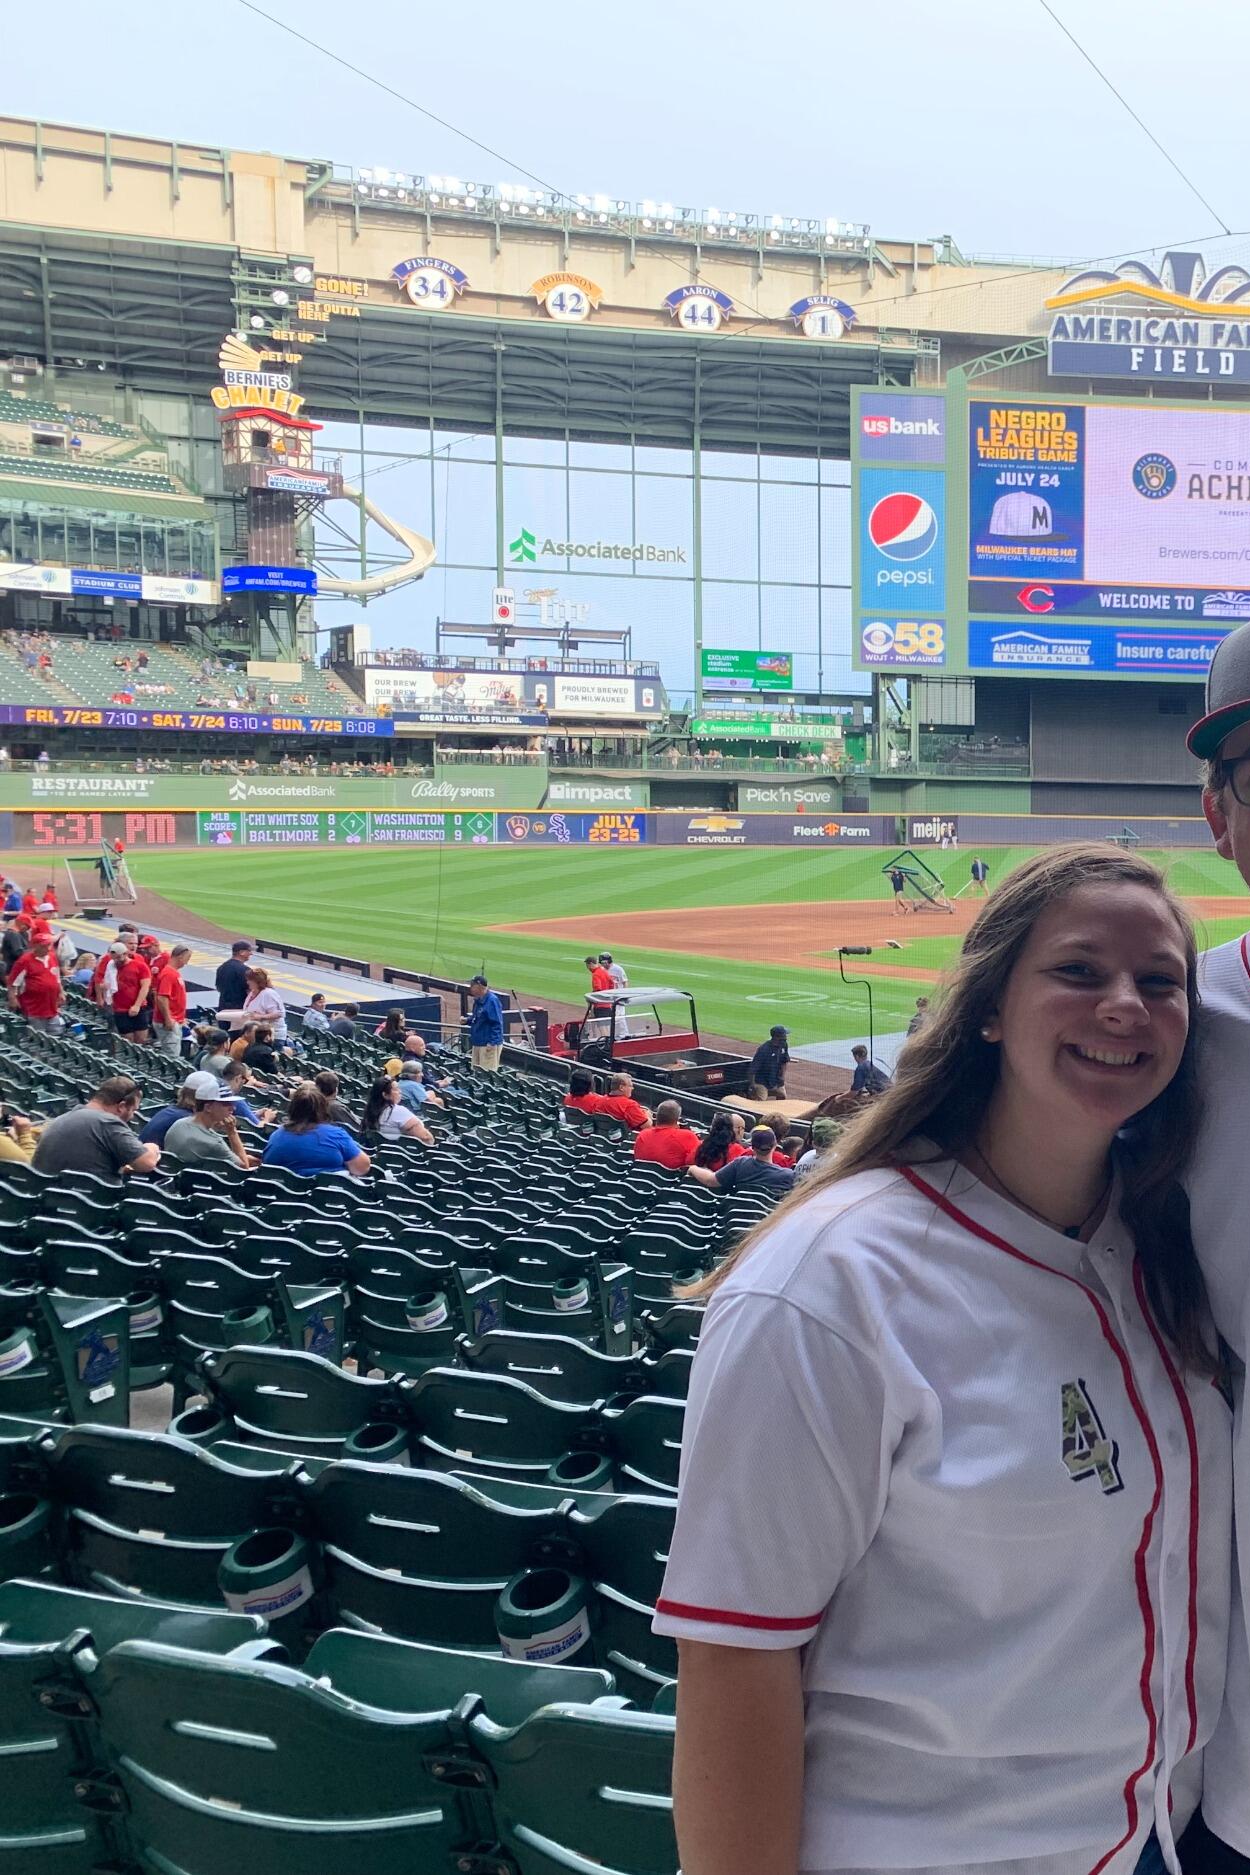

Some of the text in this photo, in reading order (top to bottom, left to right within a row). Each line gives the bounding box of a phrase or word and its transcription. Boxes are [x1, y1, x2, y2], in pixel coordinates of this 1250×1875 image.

[404, 256, 456, 276] FINGERS
[316, 278, 368, 296] GONE!
[414, 276, 447, 302] 34
[540, 272, 594, 292] ROBINSON
[682, 286, 719, 299] AARON
[298, 301, 360, 317] GET OUTTA
[552, 291, 584, 314] 42
[807, 296, 839, 308] SELIG
[298, 311, 330, 322] HERE
[684, 303, 714, 324] 44
[819, 315, 829, 336] 1
[1051, 315, 1200, 345] AMERICAN
[272, 330, 315, 343] GET UP
[260, 350, 302, 363] GET UP
[1131, 348, 1235, 375] FIELD
[226, 371, 290, 389] BERNIE'S
[211, 385, 305, 415] CHALET
[990, 409, 1067, 431] NEGRO
[977, 428, 1078, 450] LEAGUES
[978, 447, 1077, 463] TRIBUTE GAME
[995, 472, 1060, 487] JULY 24
[1031, 506, 1049, 530] M
[541, 538, 687, 563] Associated Bank
[976, 546, 1029, 555] MILWAUKEE
[73, 578, 140, 591] STADIUM CLUB
[877, 567, 933, 588] pepsi
[495, 594, 514, 605] Lite
[1098, 593, 1195, 610] WELCOME TO
[893, 621, 945, 656] 58
[993, 643, 1090, 656] AMERICAN FAMILY
[1116, 642, 1217, 661] Insure carefu
[896, 655, 943, 663] MILWAUKEE
[996, 653, 1085, 663] INSURANCE
[393, 679, 417, 687] BREW
[561, 684, 629, 696] PROUDLY BREWED
[564, 693, 626, 704] FOR MILWAUKEE
[25, 709, 375, 734] FRI, 7/23 7:10 SAT, 7/24 6:10 SUN, 7/25 6:08
[419, 714, 523, 724] GREAT TASTE. LESS FILLING.
[779, 724, 836, 738] CHECK DECK
[411, 779, 495, 801] Bally SPORTS
[565, 784, 632, 801] impact
[793, 789, 831, 803] Save
[210, 812, 229, 822] MLB
[249, 813, 336, 826] CHI WHITE SOX 8
[374, 814, 445, 826] WASHINGTON
[594, 814, 636, 829] JULY
[33, 813, 176, 845] 5:31 PM
[203, 822, 237, 831] SCORES
[793, 825, 870, 837] Fleet Farm
[912, 817, 954, 841] meijer
[249, 830, 336, 842] BALTIMORE 2
[374, 830, 462, 841] SAN FRANCISCO 9
[589, 828, 640, 842] 23-25
[687, 835, 747, 843] CHEVROLET
[1060, 1377, 1125, 1496] 4
